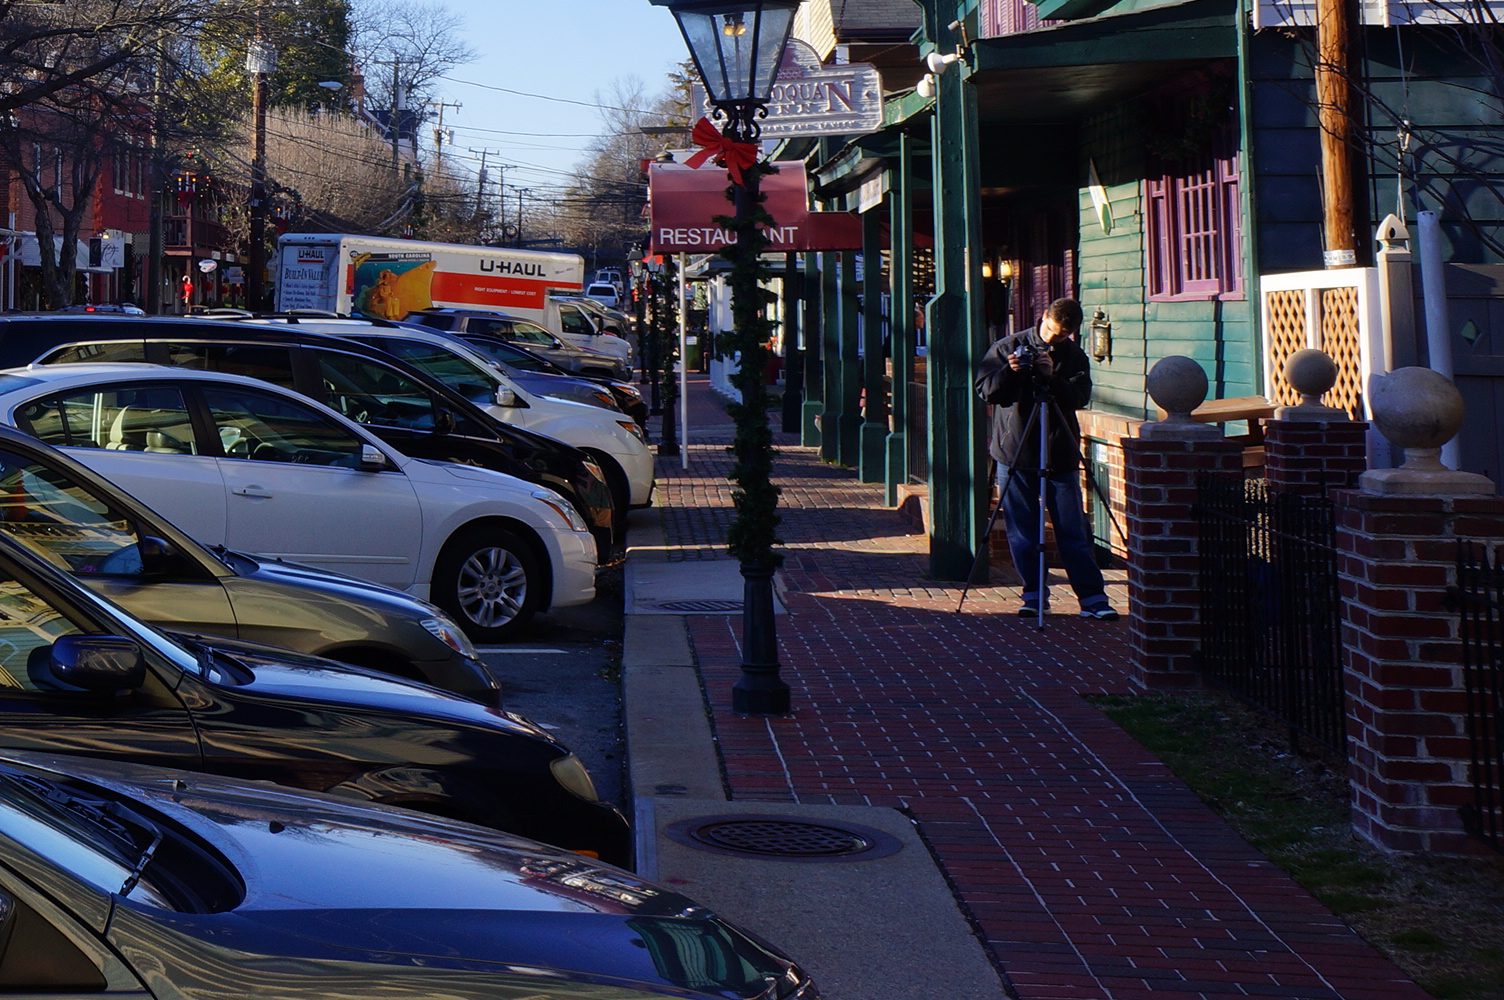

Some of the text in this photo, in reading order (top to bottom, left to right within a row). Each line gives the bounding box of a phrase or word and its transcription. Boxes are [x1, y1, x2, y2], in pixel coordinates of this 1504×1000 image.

[660, 227, 798, 245] RESTAUNT
[298, 250, 324, 259] U-HAUL
[480, 259, 546, 277] U-HAUL
